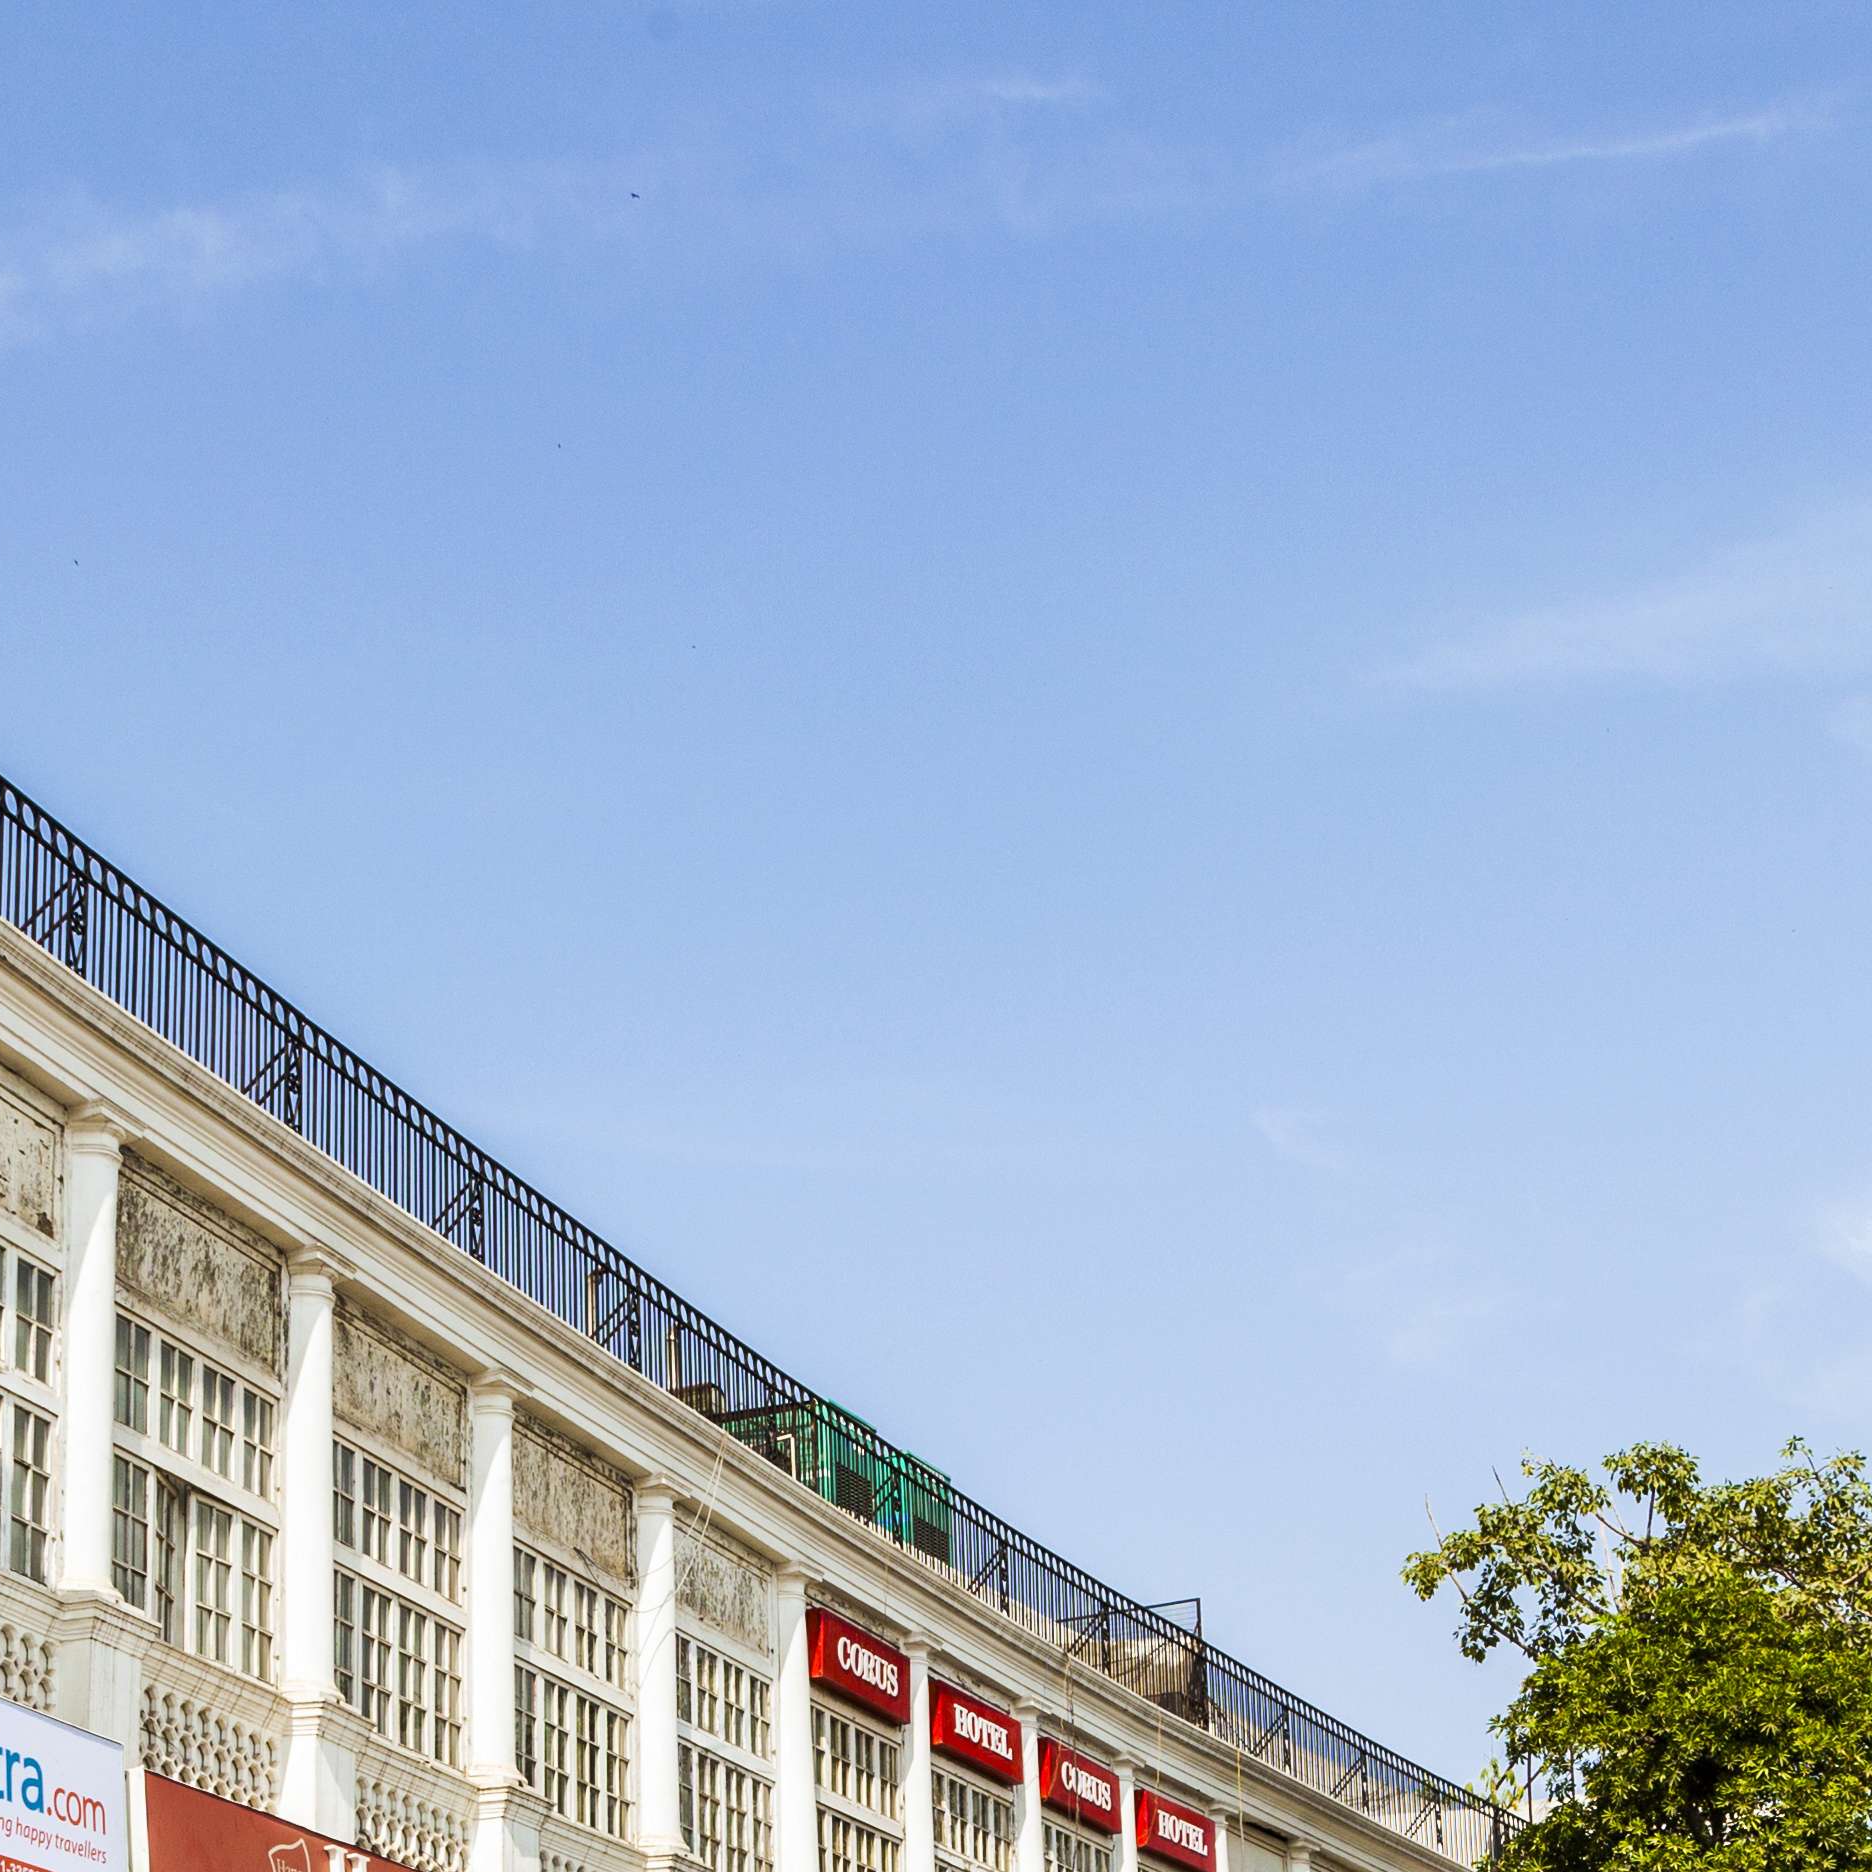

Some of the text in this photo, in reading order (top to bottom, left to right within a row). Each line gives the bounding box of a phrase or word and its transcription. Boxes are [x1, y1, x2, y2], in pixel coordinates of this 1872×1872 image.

[837, 1635, 899, 1698] CORUS
[953, 1703, 1013, 1760] HOTEL
[15, 1817, 53, 1850] happy
[54, 1835, 108, 1865] travellers
[1157, 1808, 1208, 1856] HOTEL
